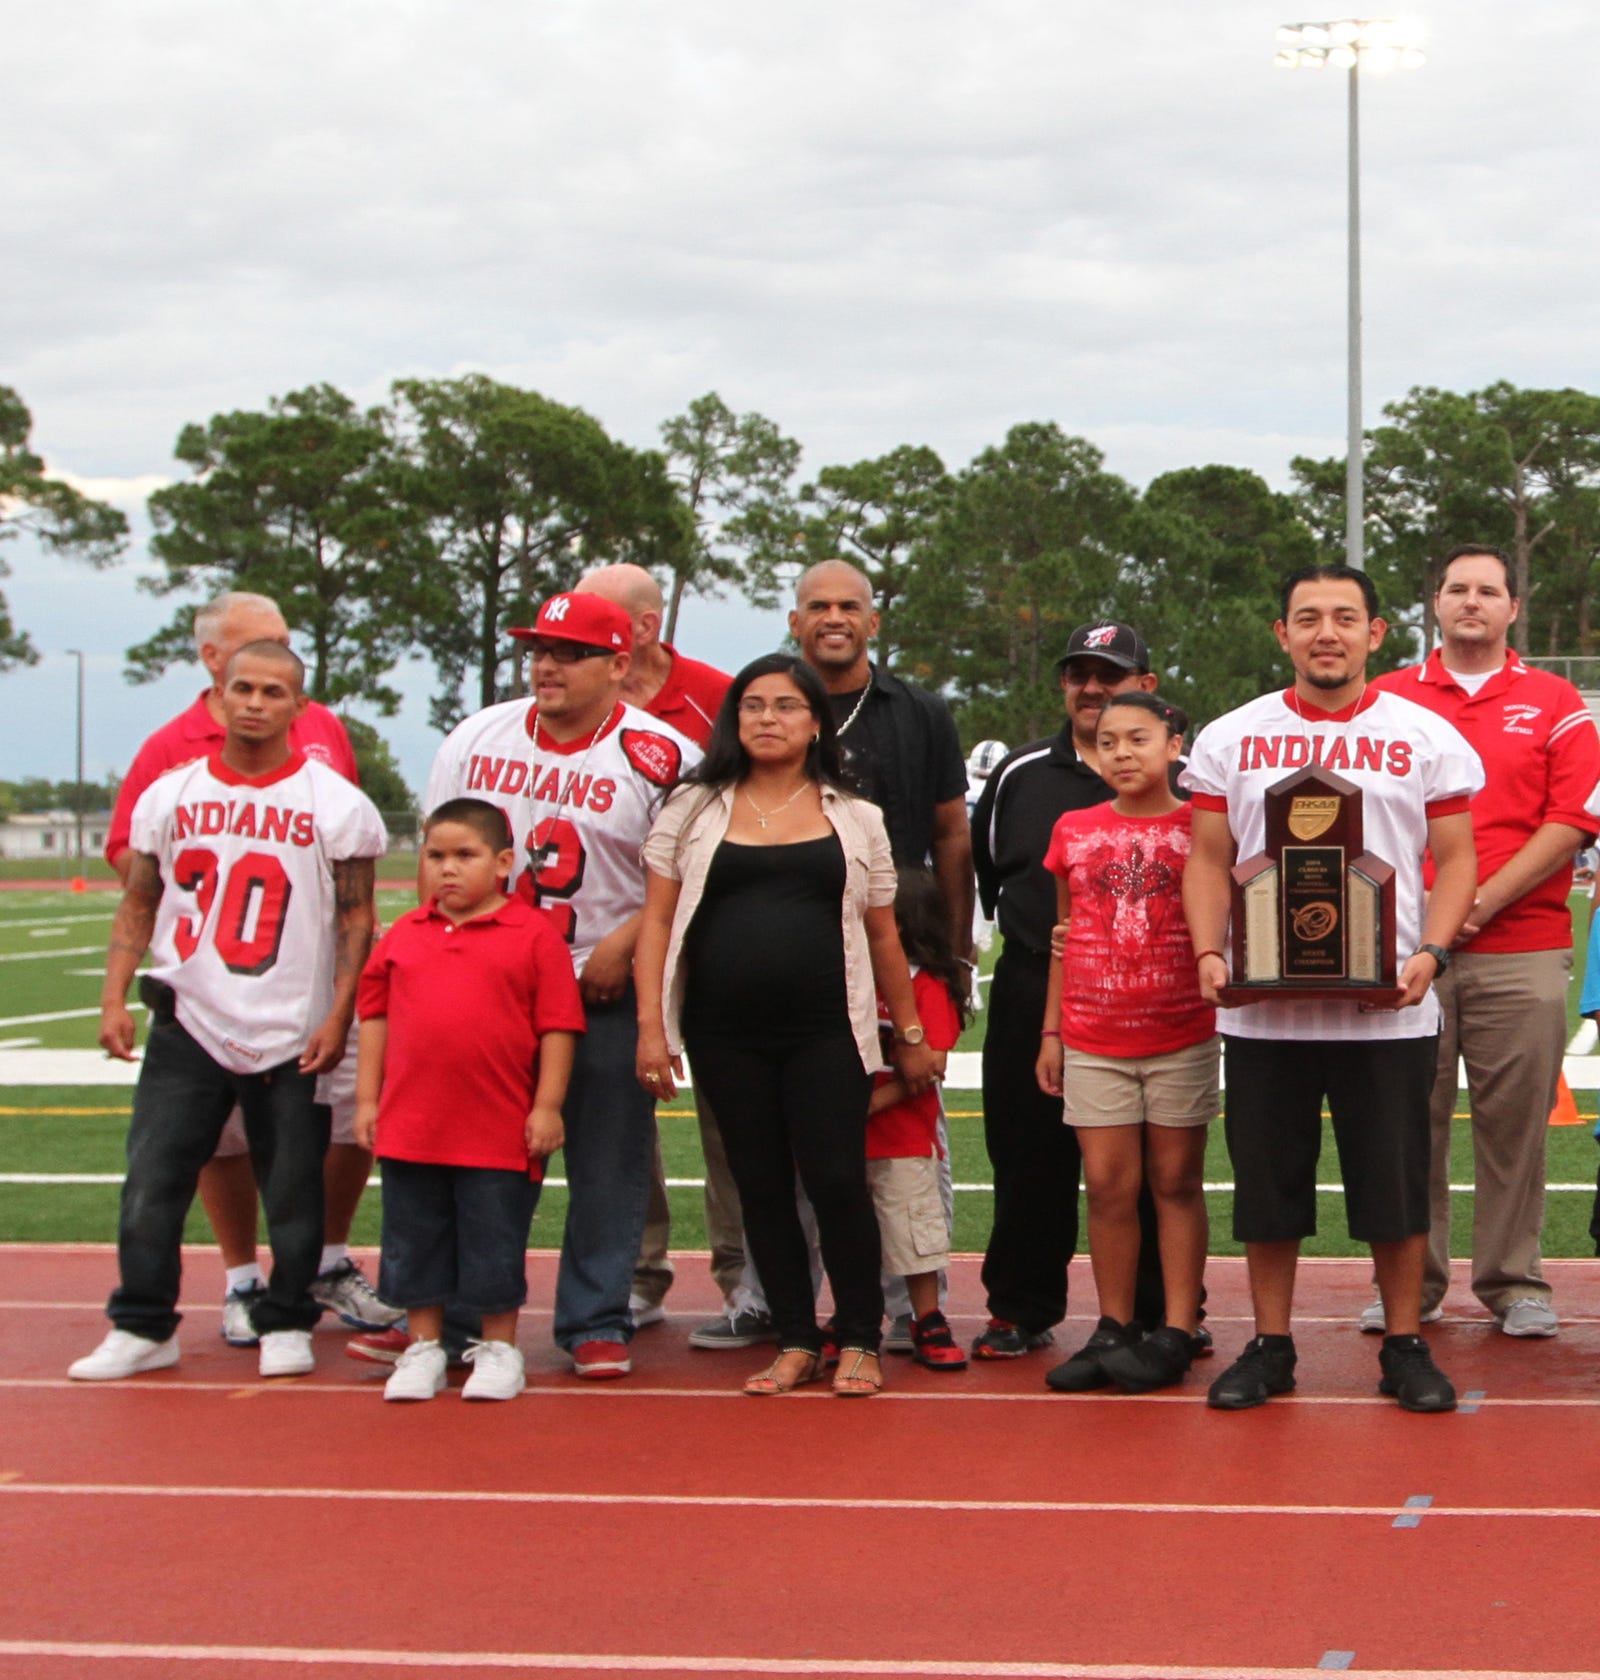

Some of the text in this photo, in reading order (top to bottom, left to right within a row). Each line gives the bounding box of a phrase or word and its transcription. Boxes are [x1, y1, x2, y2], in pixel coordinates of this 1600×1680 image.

[544, 597, 571, 621] NY
[1239, 735, 1413, 777] INDIANS
[466, 755, 617, 814] INDIANS
[172, 800, 315, 847] NDIANS
[173, 848, 293, 977] 30
